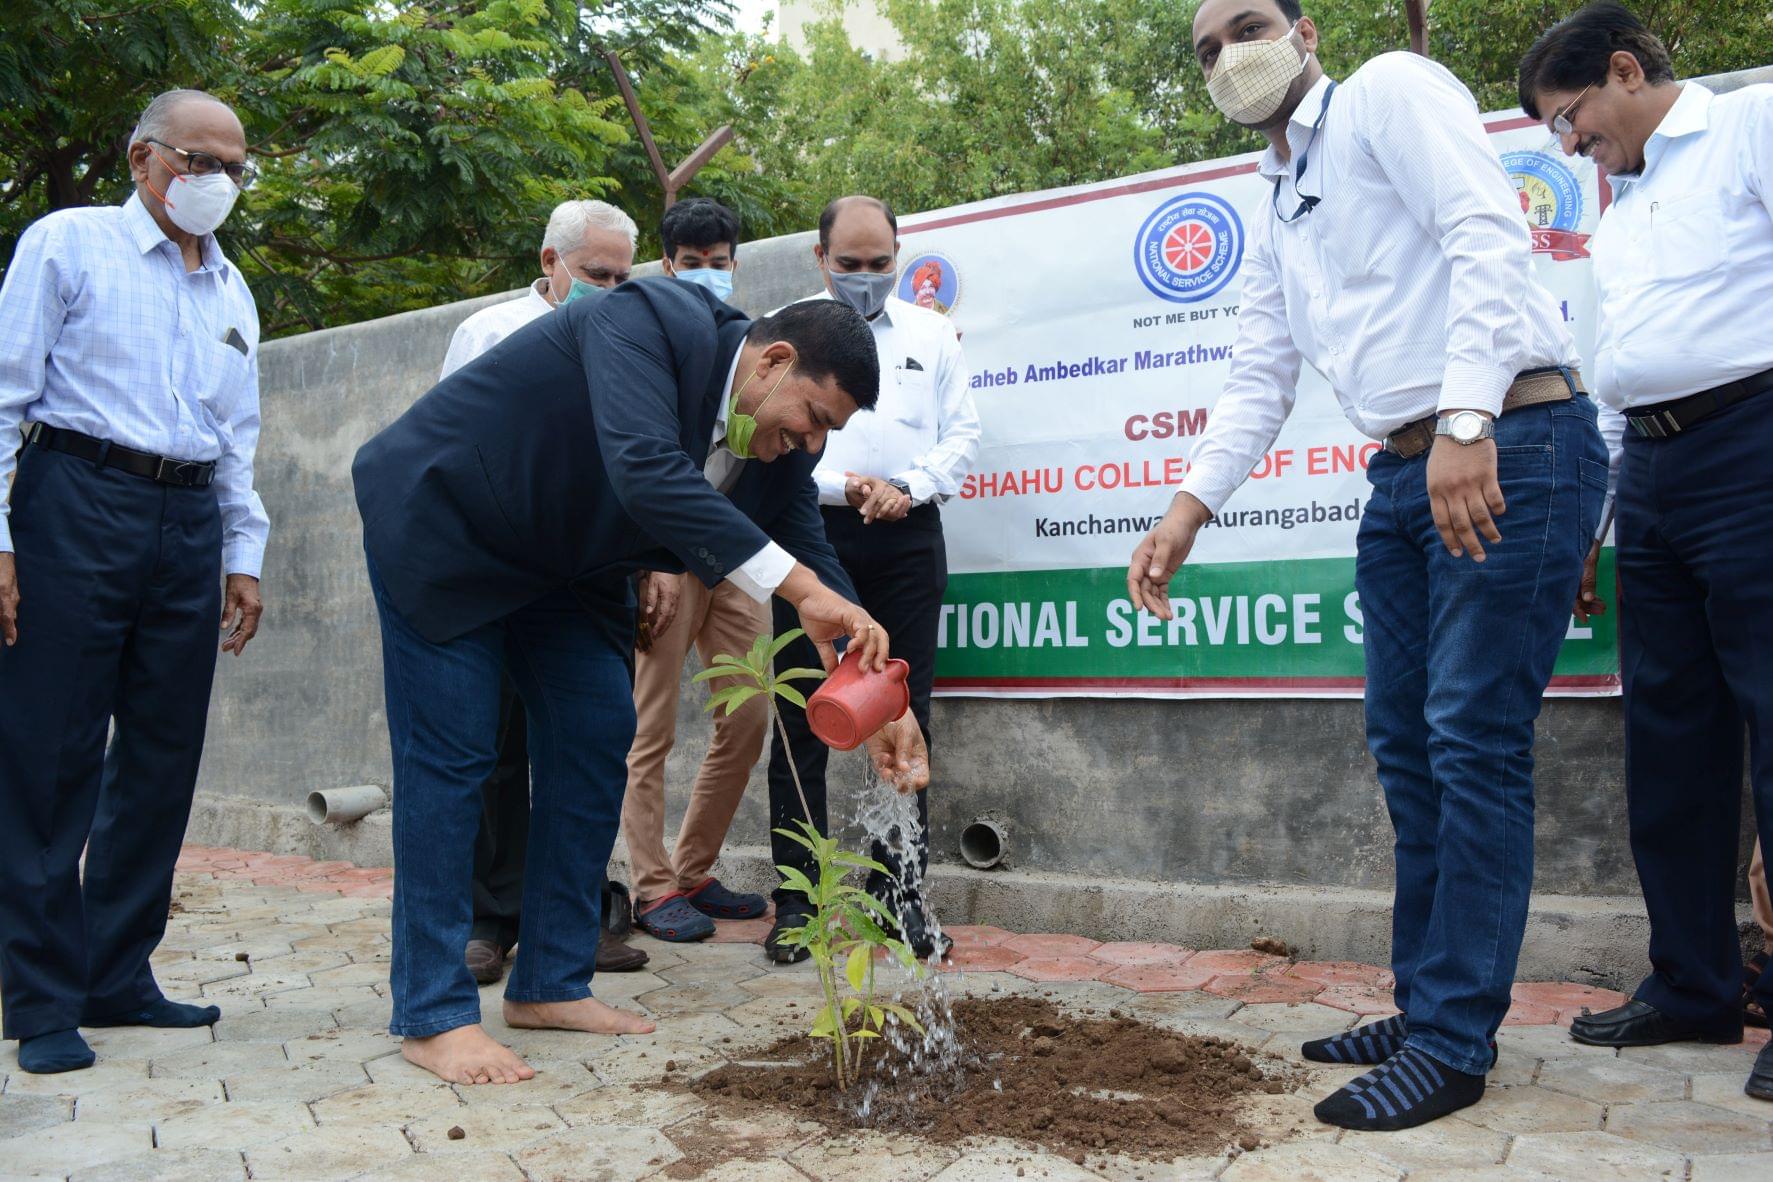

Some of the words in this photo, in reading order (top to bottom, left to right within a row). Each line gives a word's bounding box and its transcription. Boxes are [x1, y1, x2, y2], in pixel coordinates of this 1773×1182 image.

[1526, 158, 1541, 168] OF
[1540, 163, 1574, 218] ENGINEERING
[1149, 240, 1172, 284] NATIONAL
[1171, 269, 1214, 288] SERVICE
[1210, 230, 1229, 273] SCHEME
[1133, 315, 1161, 329] NOT
[1165, 312, 1186, 325] ME
[1190, 308, 1219, 322] BUT
[968, 366, 1018, 389] aheb
[1024, 356, 1128, 383] Ambedkar
[1124, 407, 1214, 441] CSM
[959, 467, 1064, 499] SHAHU
[1074, 457, 1191, 491] COLLE
[1248, 448, 1296, 479] OF
[1203, 497, 1360, 529] Aurangabad
[1105, 593, 1322, 648] SERVICE
